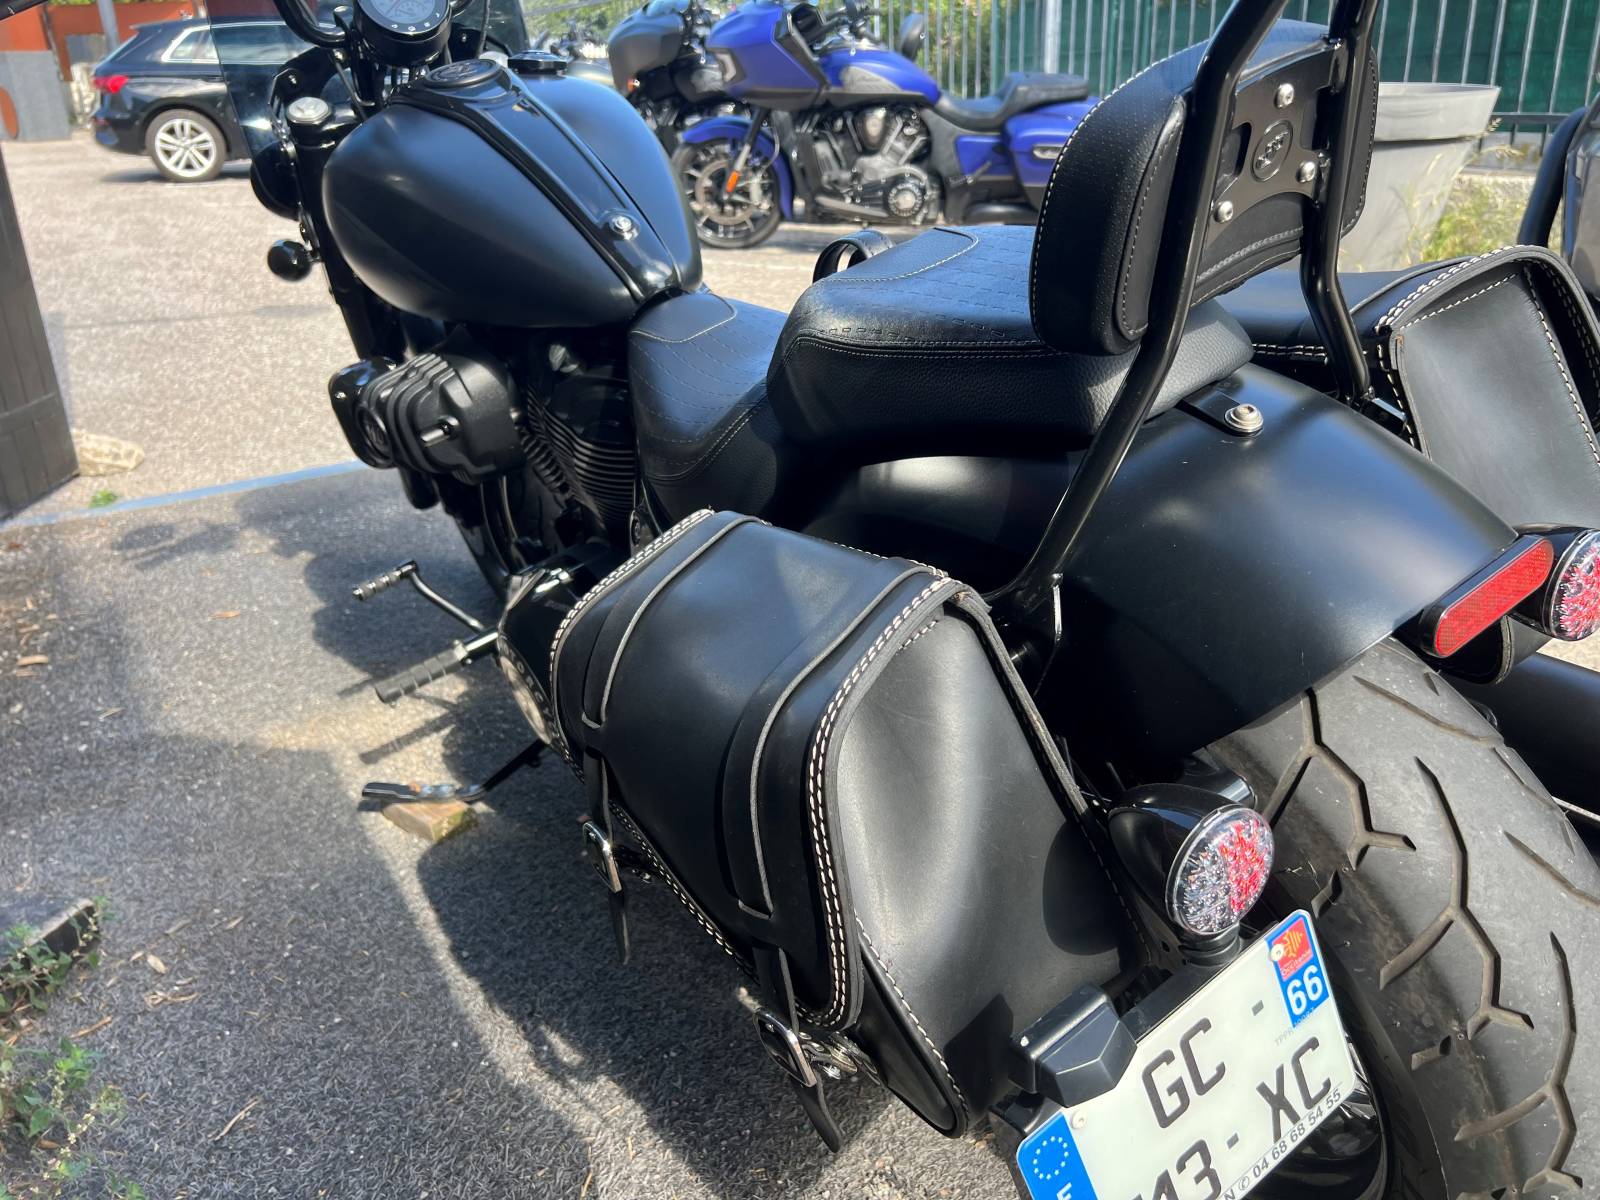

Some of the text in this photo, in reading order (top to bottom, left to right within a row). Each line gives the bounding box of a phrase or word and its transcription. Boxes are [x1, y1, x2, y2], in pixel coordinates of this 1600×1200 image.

[1287, 964, 1323, 1016] 66
[1142, 1017, 1226, 1129] GC
[1256, 1036, 1331, 1144] XC
[1252, 1157, 1269, 1178] 04
[1271, 1140, 1288, 1161] 68
[1290, 1123, 1306, 1143] 68
[1307, 1105, 1323, 1126] 54
[1325, 1088, 1341, 1109] 55
